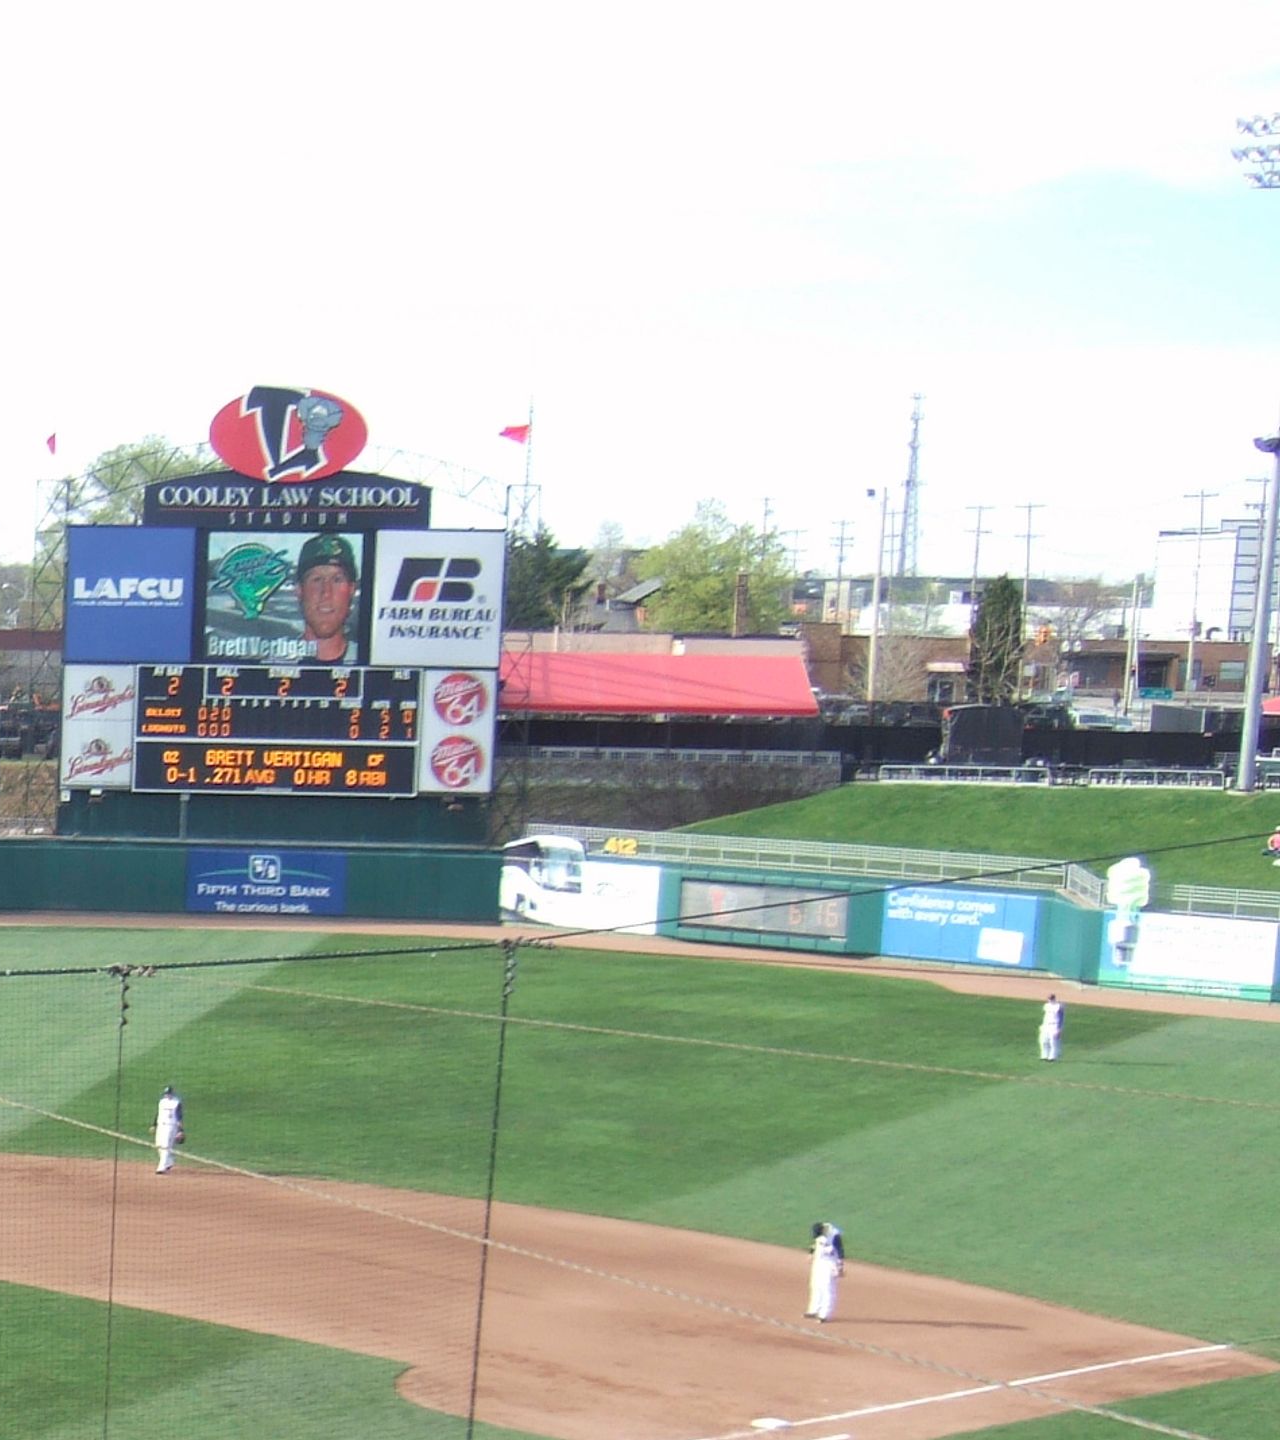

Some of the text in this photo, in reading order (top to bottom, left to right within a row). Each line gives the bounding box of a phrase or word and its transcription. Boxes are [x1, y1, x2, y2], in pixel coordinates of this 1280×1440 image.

[158, 486, 419, 508] COOLEY LAW SCHOOL
[229, 512, 348, 526] STADIUM
[73, 577, 184, 600] LAFCU
[378, 608, 496, 622] FARM BUREAU
[389, 625, 483, 640] INSURANCE
[168, 677, 179, 695] 2
[222, 678, 233, 695] 2
[278, 679, 290, 696] 2
[335, 680, 347, 697] 2
[446, 697, 480, 724] 64
[205, 750, 254, 766] BRETT
[263, 751, 343, 768] VERTIGAN
[166, 767, 196, 783] 0-1
[204, 769, 240, 784] .271
[244, 770, 275, 784] AVG
[307, 771, 331, 785] HR
[444, 760, 476, 786] 64
[604, 837, 638, 852] 412
[197, 883, 330, 897] FIFTH THIRD BANK
[214, 901, 312, 914] The curious bank.
[888, 892, 996, 914] Confidence comes
[888, 907, 914, 919] with
[914, 911, 949, 926] every
